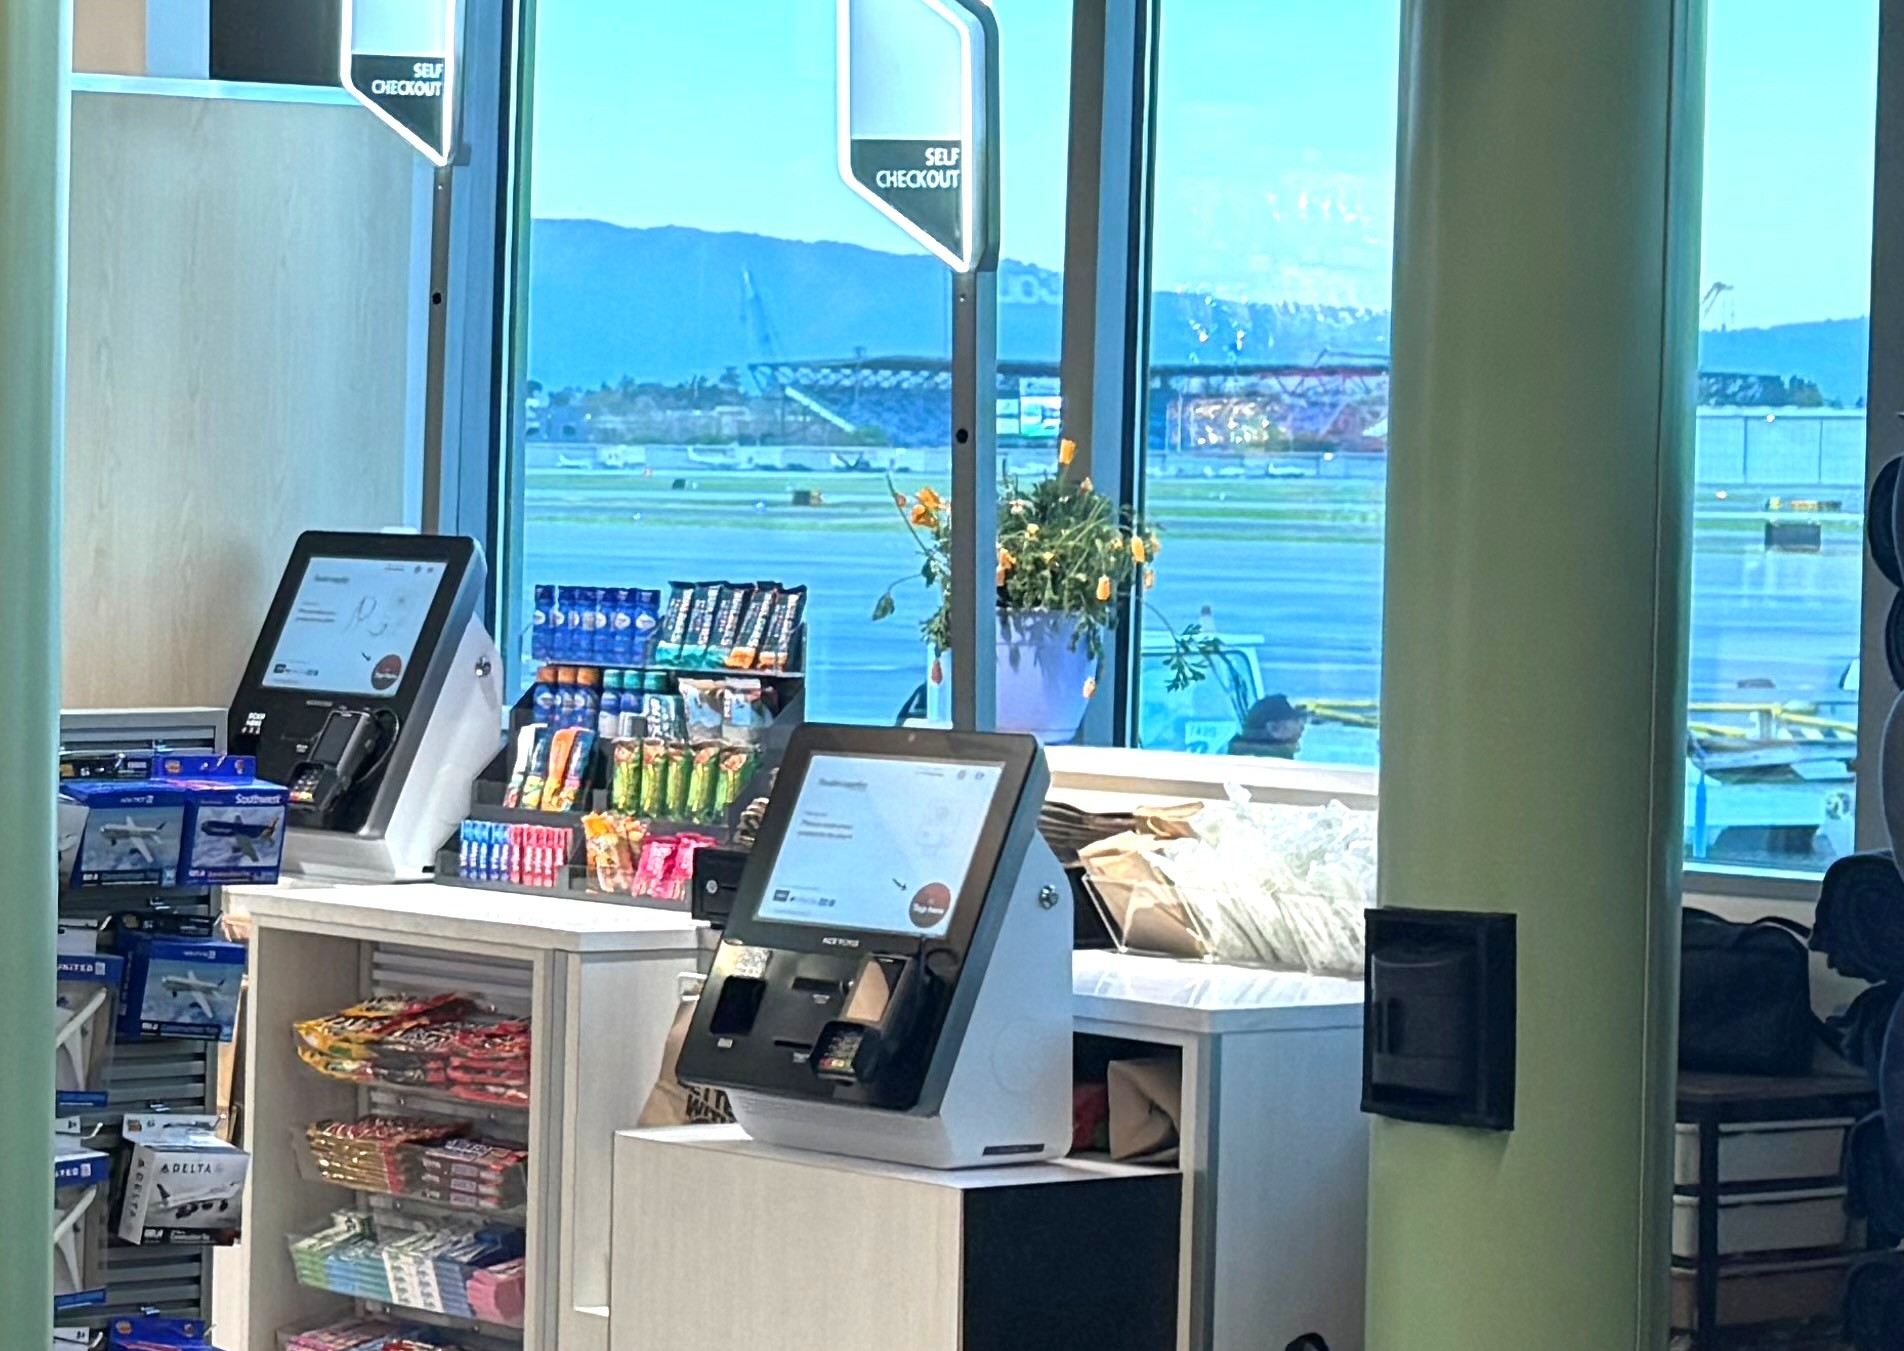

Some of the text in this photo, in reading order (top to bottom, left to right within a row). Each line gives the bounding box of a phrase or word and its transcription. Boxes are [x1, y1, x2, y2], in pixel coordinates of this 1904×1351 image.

[413, 63, 444, 78] SELF
[371, 79, 443, 96] CHECKOUT
[924, 148, 961, 166] SELF
[875, 168, 961, 189] CHECKOUT
[235, 794, 281, 806] Southwest
[172, 1163, 212, 1174] DELTA
